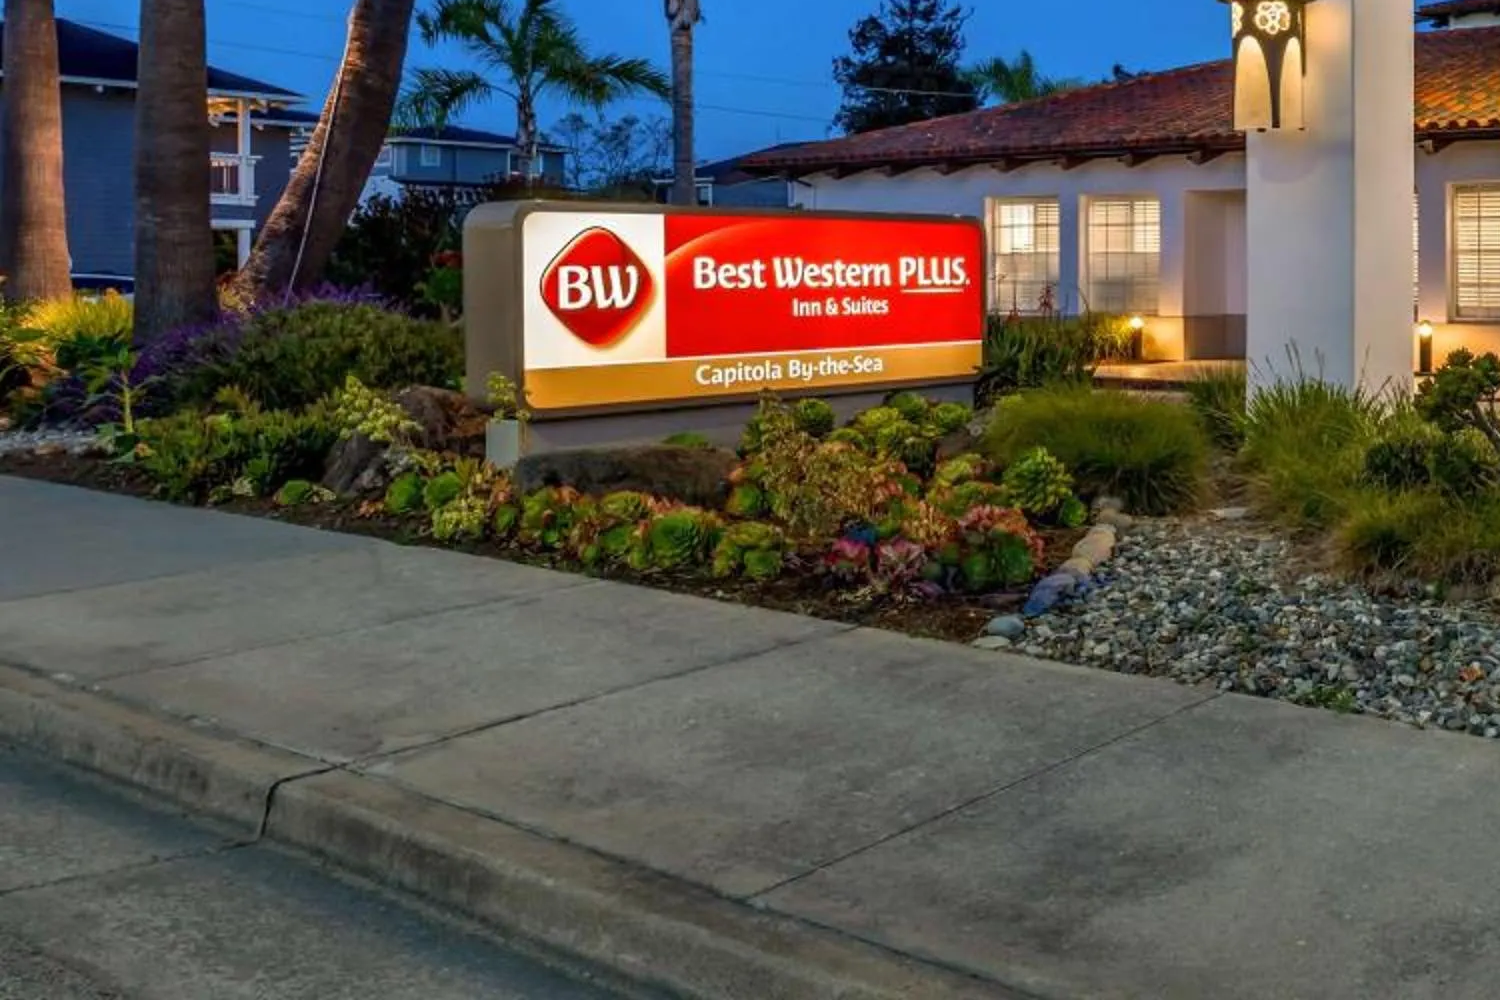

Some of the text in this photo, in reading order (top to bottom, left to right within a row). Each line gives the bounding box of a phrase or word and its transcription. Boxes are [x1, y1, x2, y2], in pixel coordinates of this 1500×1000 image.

[557, 265, 639, 310] BW
[693, 256, 767, 289] Best
[772, 256, 891, 288] Western
[792, 296, 889, 317] Inn & Suites
[695, 354, 884, 387] Capitola By-the-Sea
